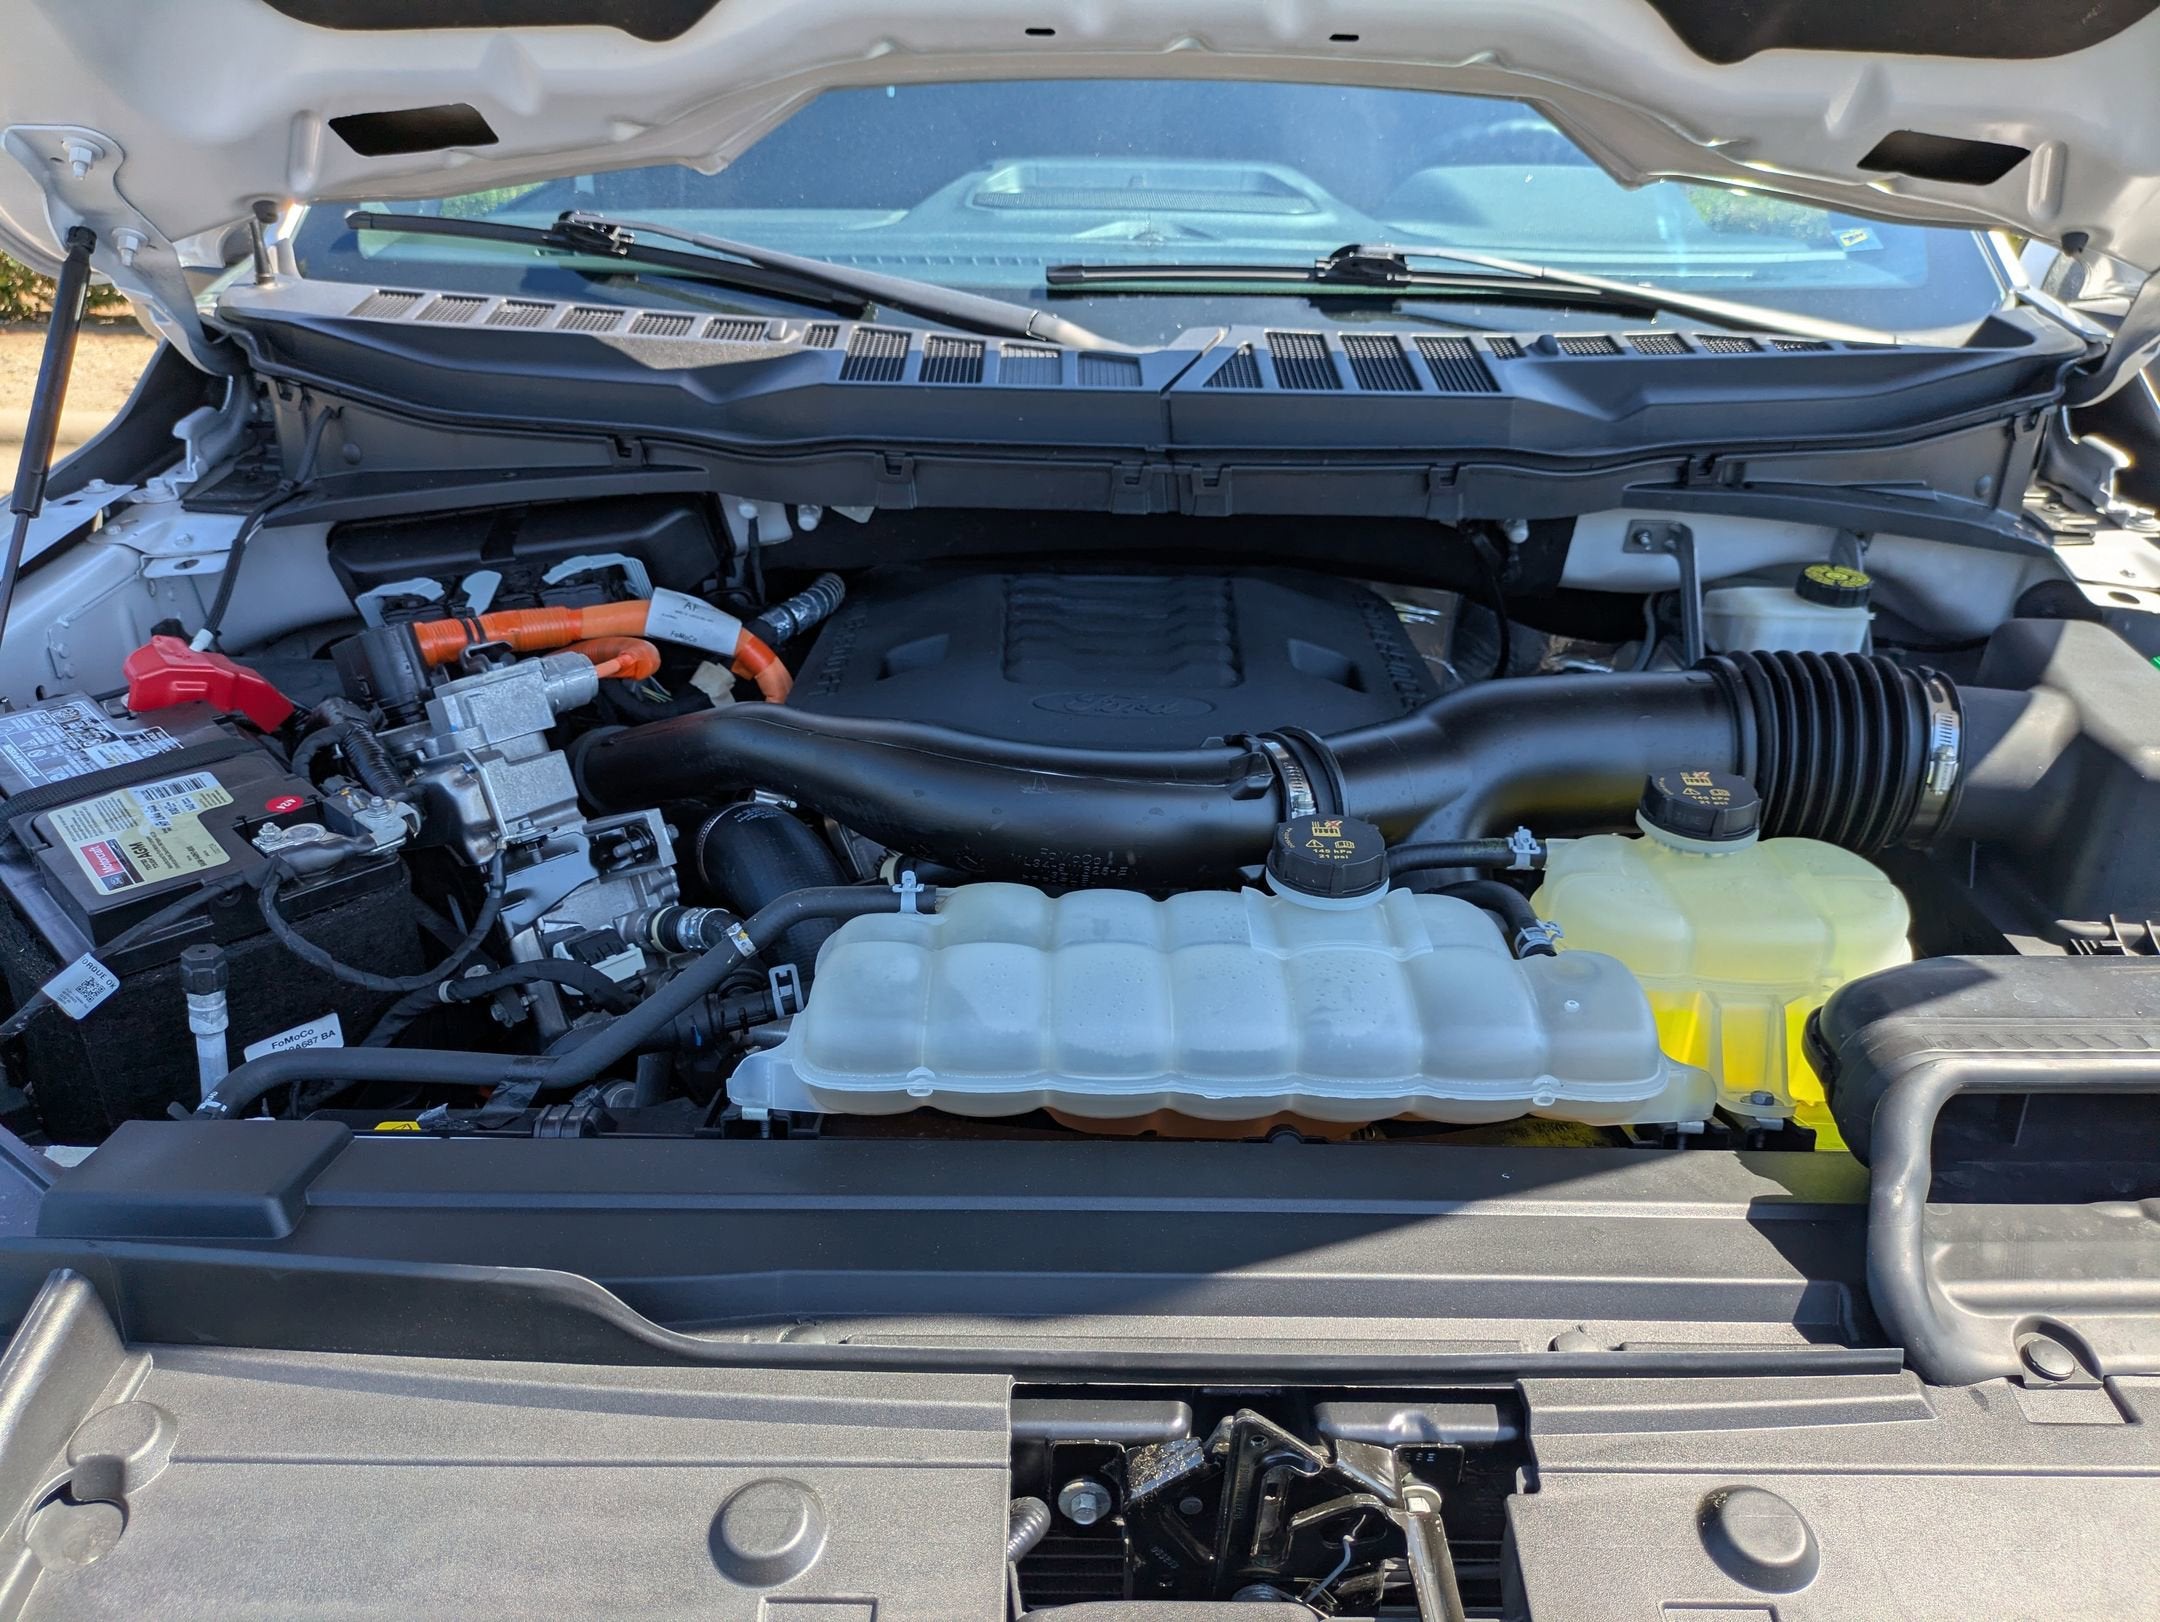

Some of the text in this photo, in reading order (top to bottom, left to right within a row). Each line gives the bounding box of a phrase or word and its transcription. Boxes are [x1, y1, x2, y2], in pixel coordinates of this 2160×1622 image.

[89, 844, 114, 873] Motorcraft
[128, 841, 151, 859] AGM
[106, 979, 117, 990] OK
[271, 1029, 314, 1049] FoMoCo
[321, 1029, 336, 1040] BA
